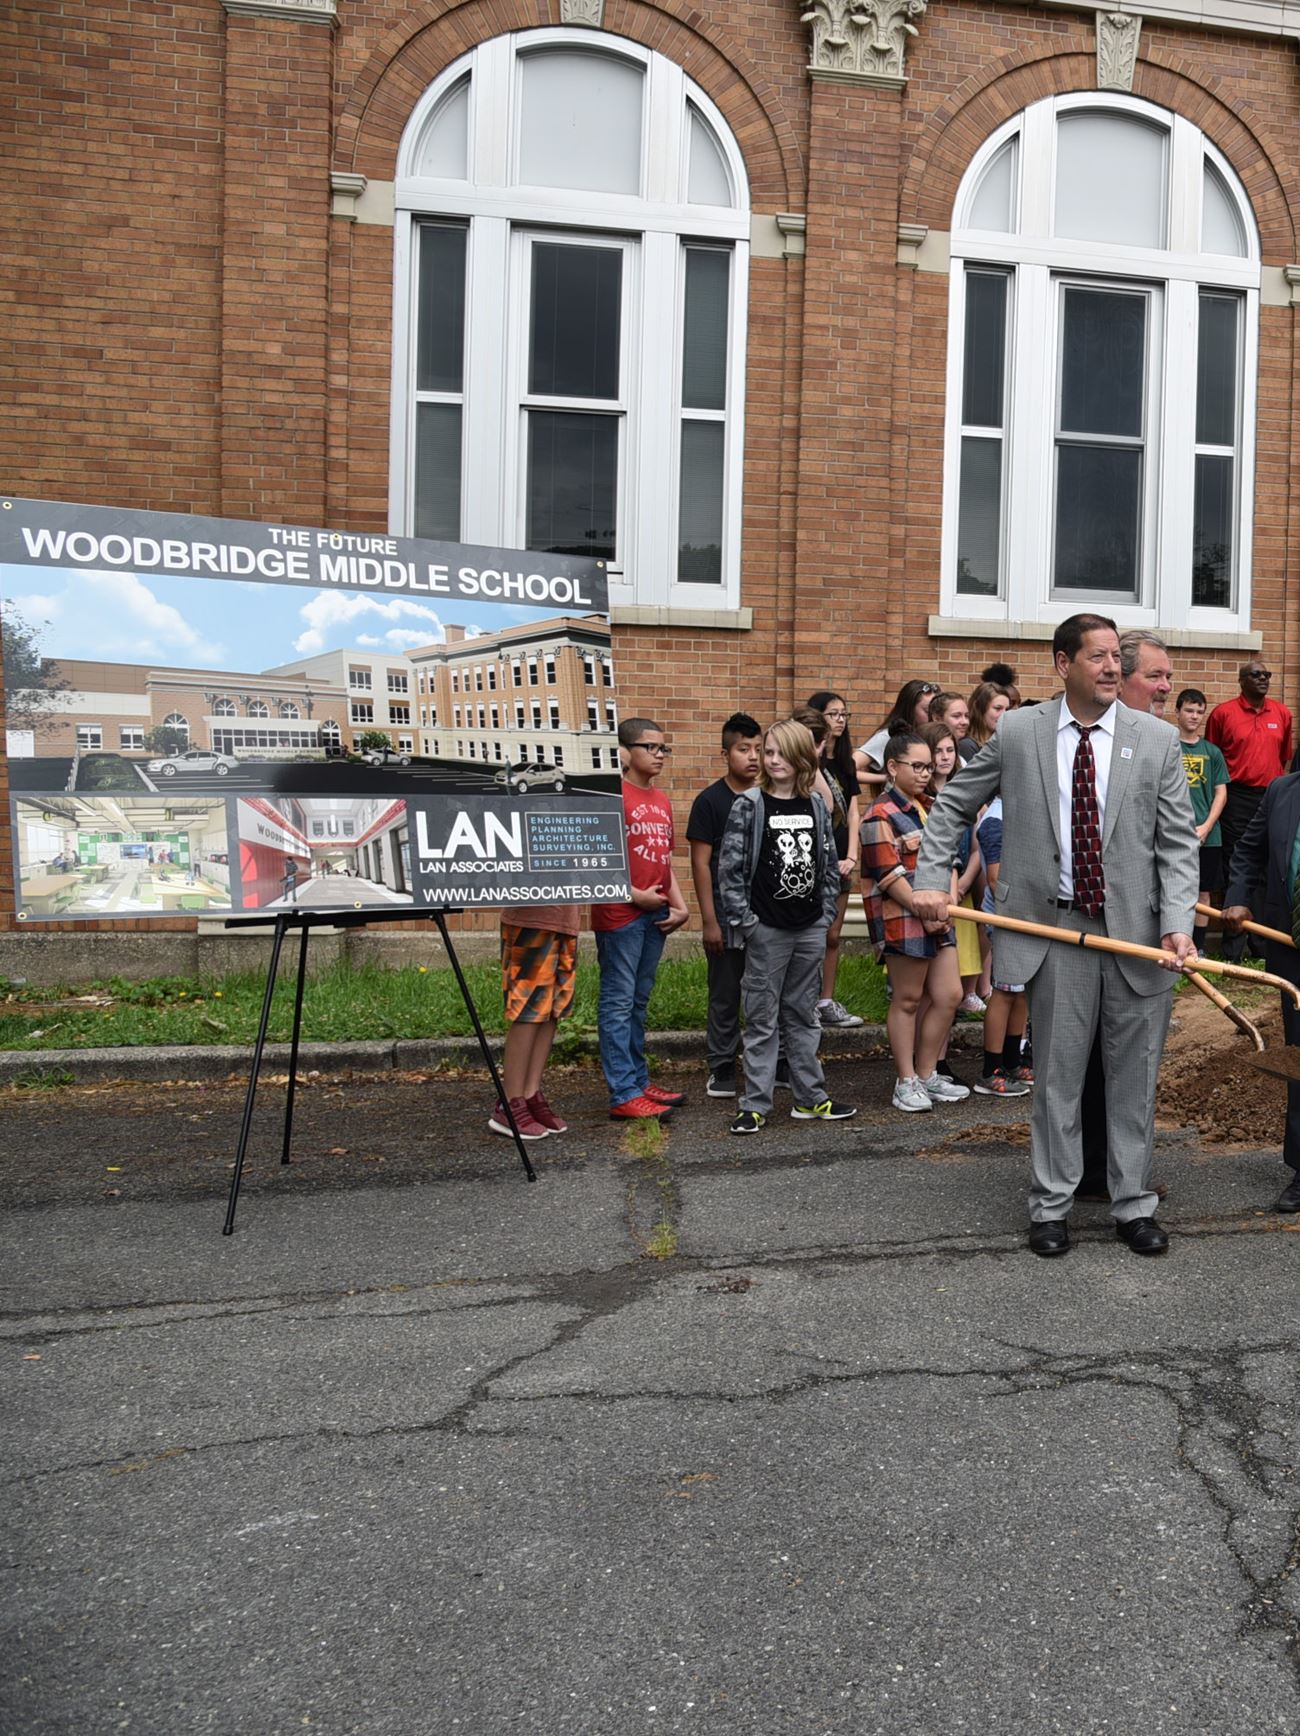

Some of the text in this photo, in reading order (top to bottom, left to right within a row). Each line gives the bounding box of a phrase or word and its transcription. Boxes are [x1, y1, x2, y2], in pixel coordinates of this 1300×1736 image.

[268, 528, 397, 556] THE FUTURE
[22, 527, 592, 605] WOODBRIDGE MIDDLE SCHOOL
[631, 804, 648, 820] EST
[530, 816, 600, 825] ENGINEERING
[772, 818, 812, 826] NO SERVICE
[415, 811, 523, 858] LAN
[531, 825, 582, 833] PLANNING
[532, 834, 609, 843] ARCHITECTURE
[532, 843, 616, 852] SURVEYING, INC.
[633, 844, 658, 863] ALL
[419, 861, 524, 873] LAN ASSOCIATES
[533, 857, 608, 868] SINCE 1965
[422, 884, 628, 902] WWW.LANASSOCIATES.COM
